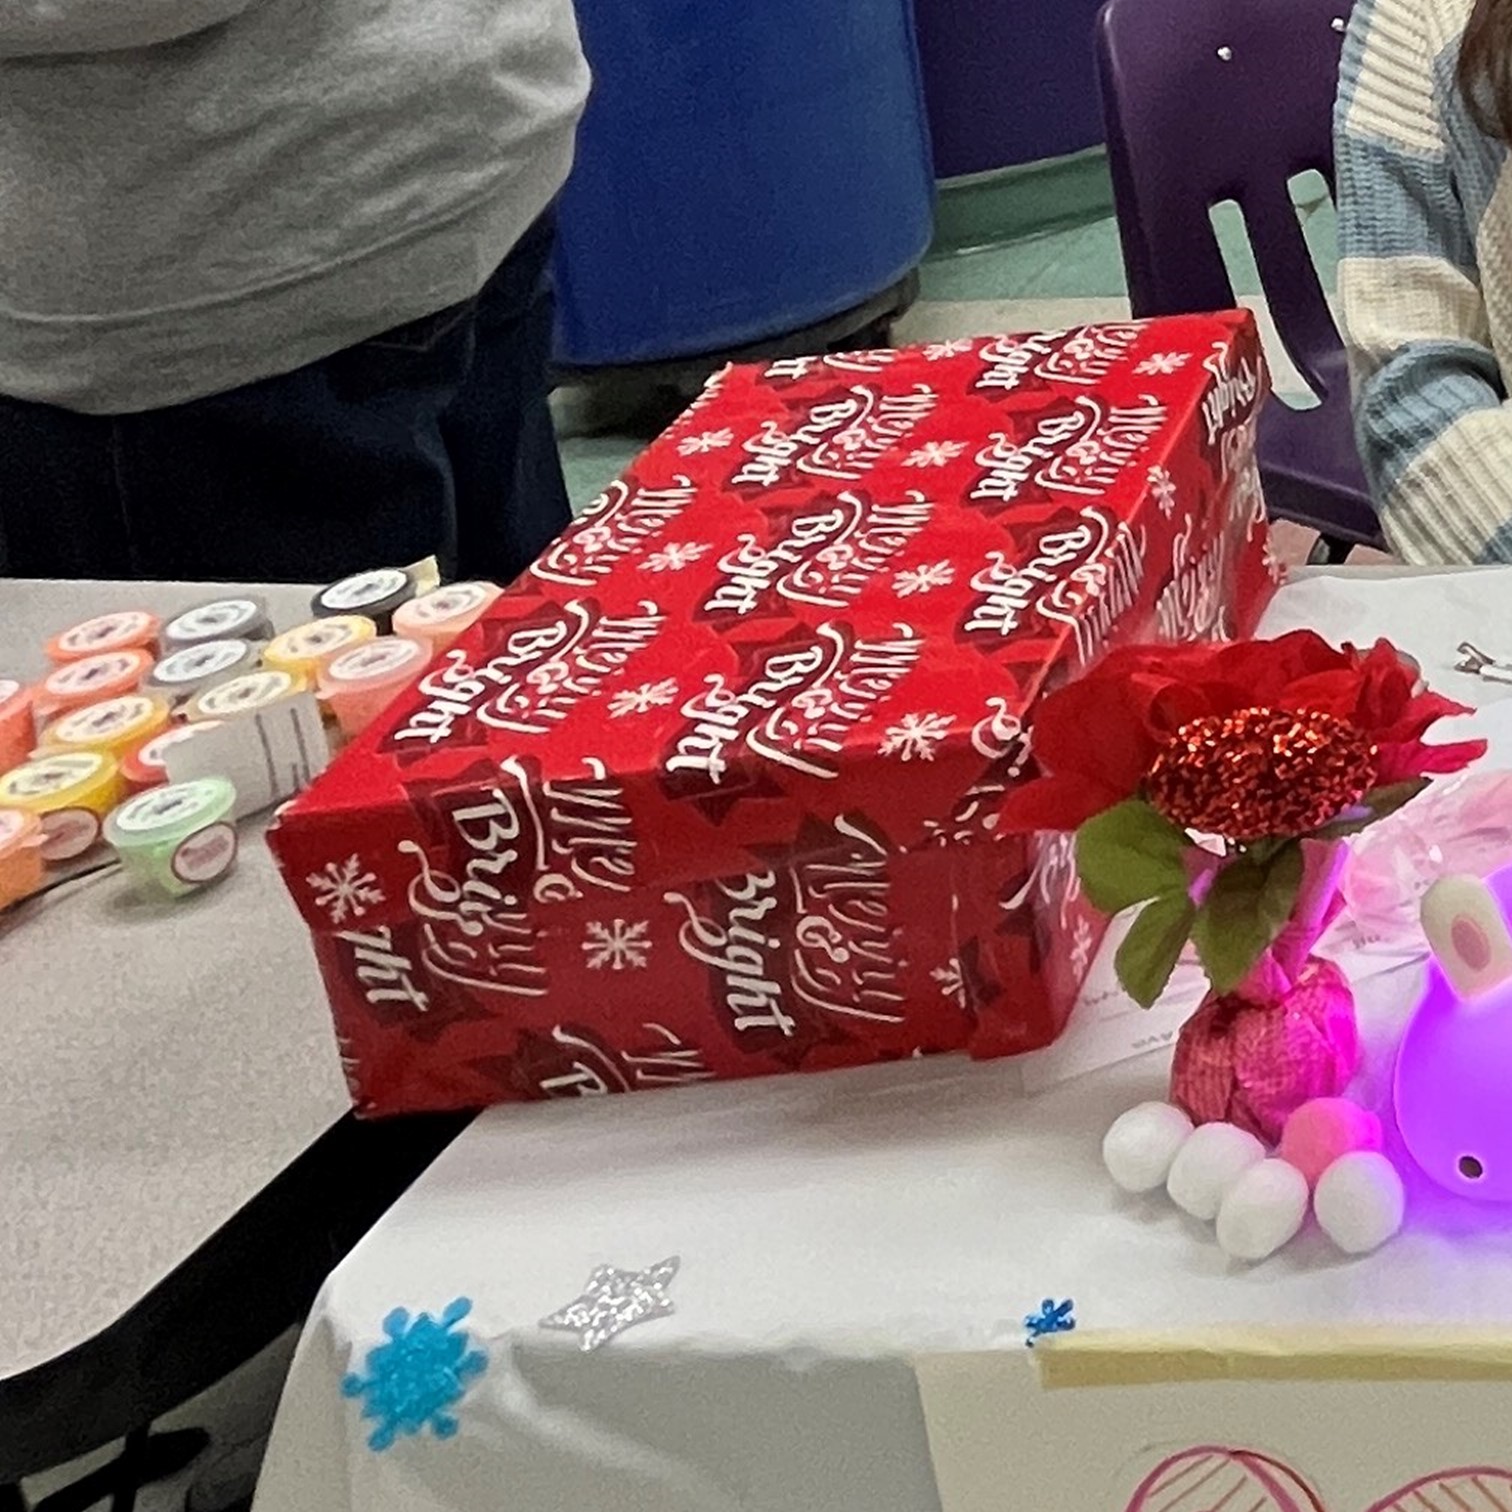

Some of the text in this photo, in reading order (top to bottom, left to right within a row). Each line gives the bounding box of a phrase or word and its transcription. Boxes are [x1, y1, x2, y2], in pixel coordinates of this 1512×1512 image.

[732, 399, 858, 486] Bright
[970, 411, 1086, 502] Bright
[704, 509, 844, 614] Bright
[964, 525, 1091, 635] Bright
[394, 621, 568, 743] Bright
[666, 646, 823, 784] Bright
